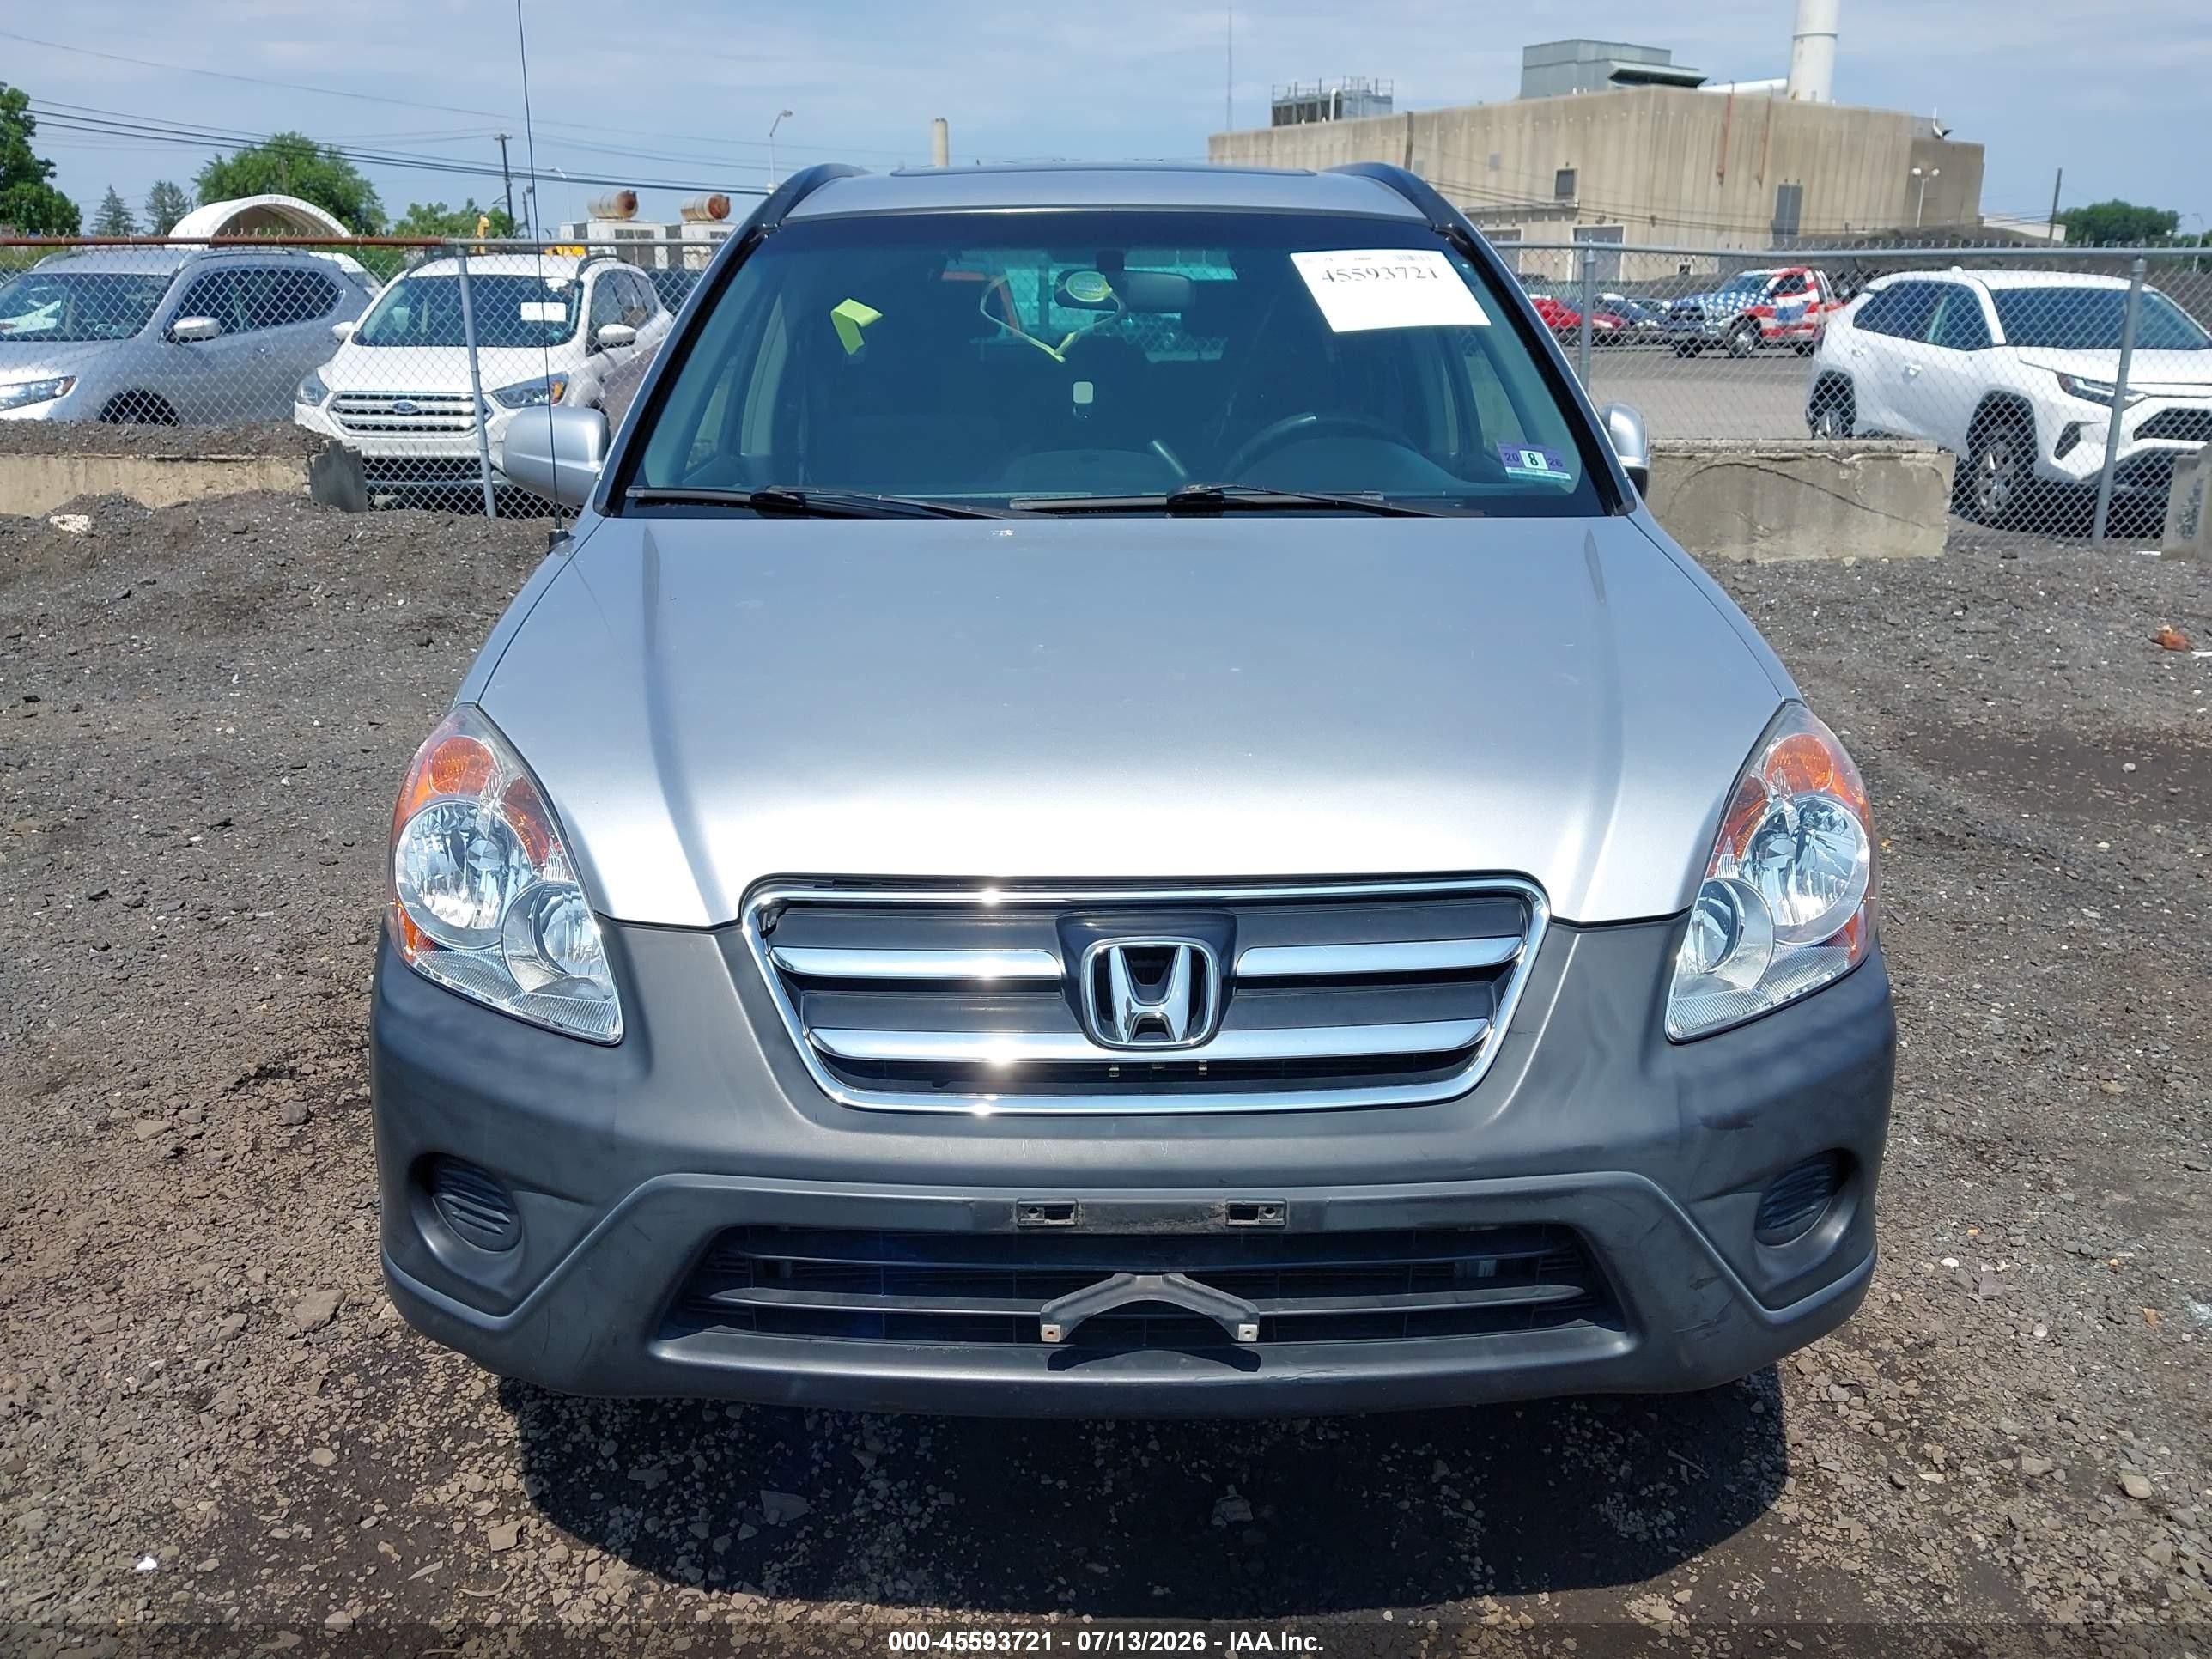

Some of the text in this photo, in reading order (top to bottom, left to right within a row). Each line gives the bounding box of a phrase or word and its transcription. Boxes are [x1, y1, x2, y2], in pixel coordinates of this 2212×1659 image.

[1322, 266, 1438, 283] 45593721
[1504, 453, 1520, 462] 20
[1528, 452, 1539, 466] 8
